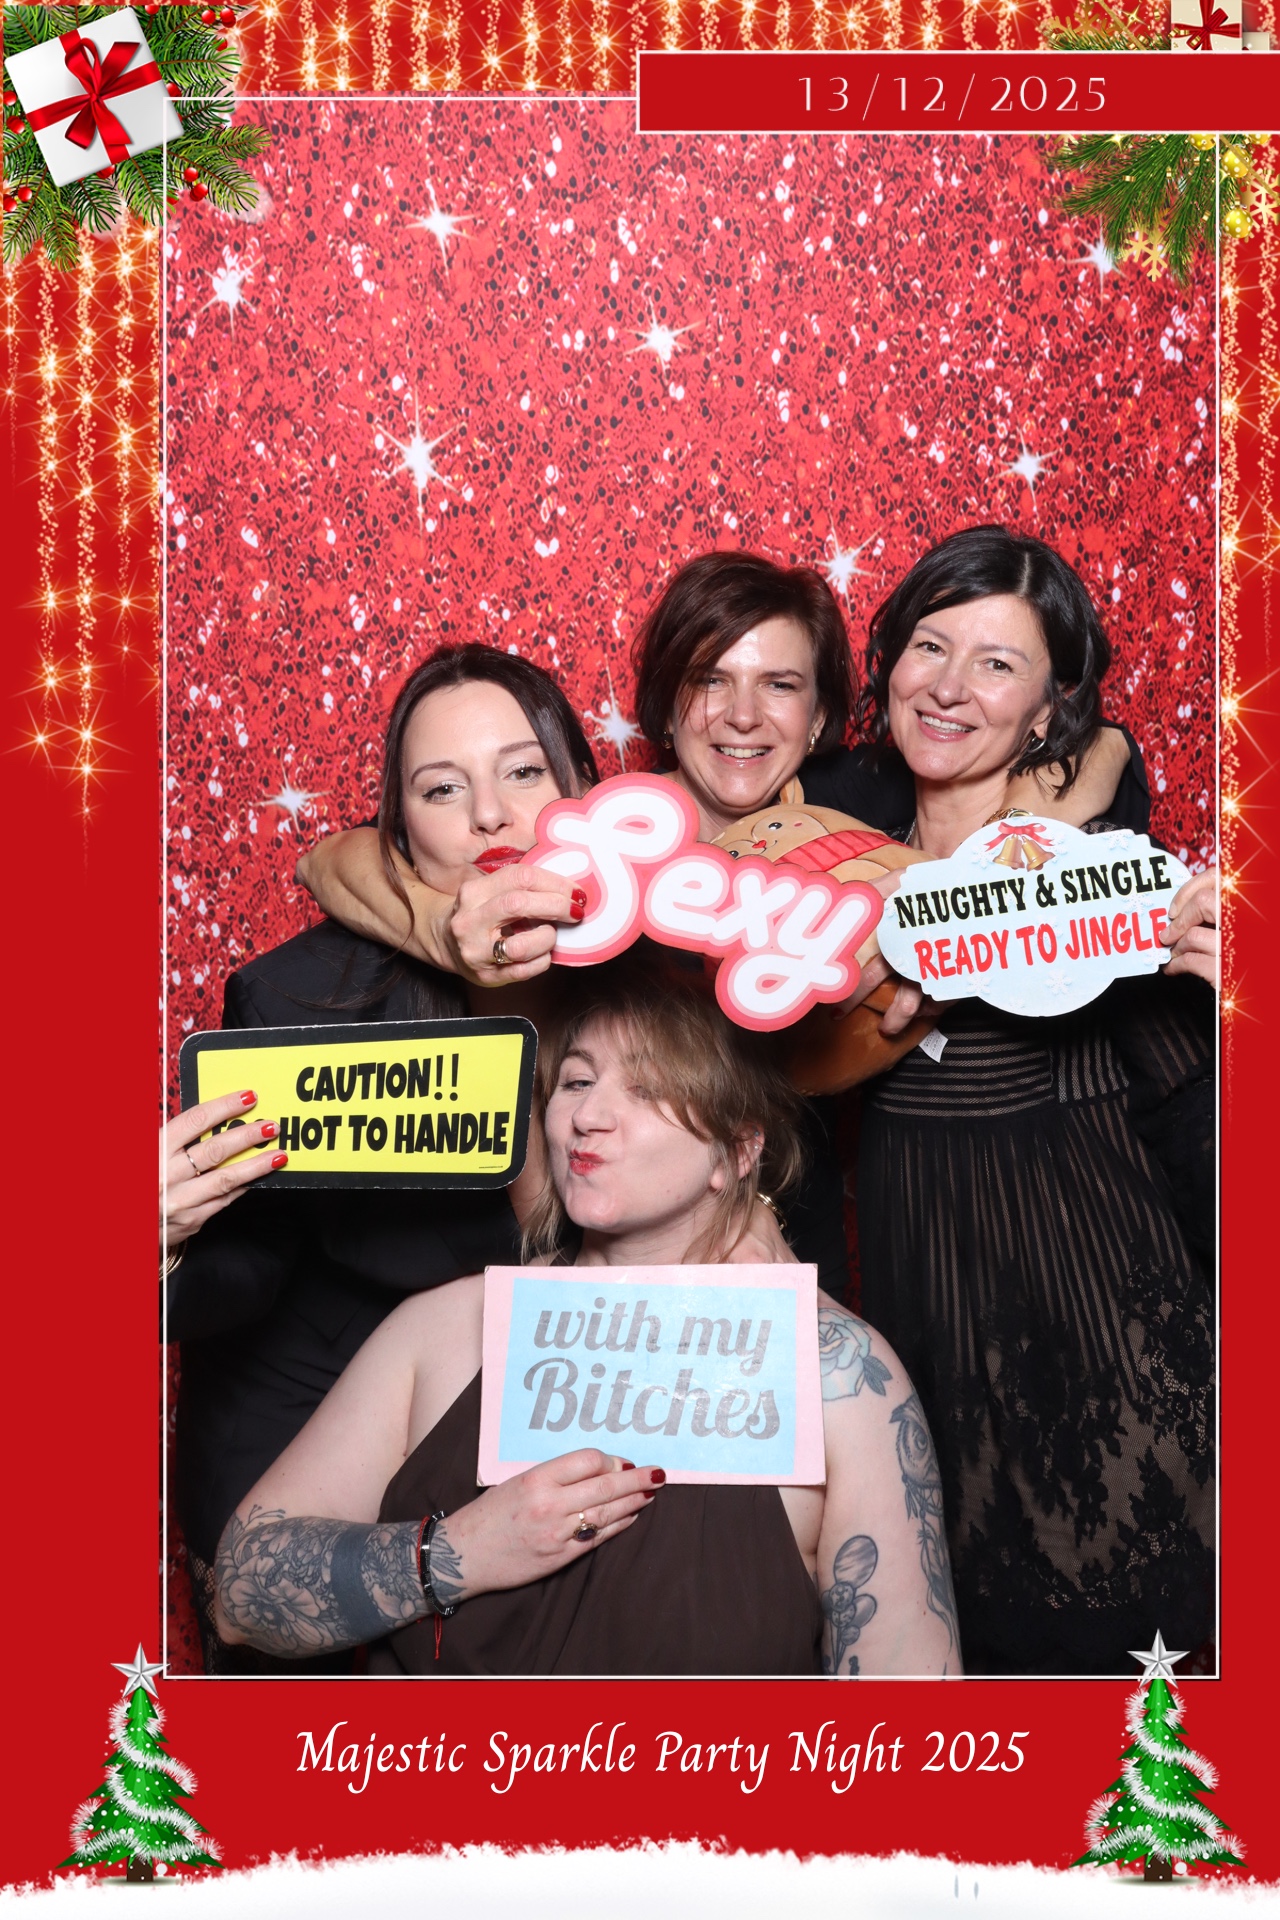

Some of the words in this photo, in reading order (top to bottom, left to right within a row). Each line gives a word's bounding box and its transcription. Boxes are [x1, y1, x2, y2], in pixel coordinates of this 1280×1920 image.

[540, 791, 866, 1014] Sexy
[894, 877, 1026, 929] NAUGHTY
[1035, 873, 1058, 908] &
[1060, 855, 1172, 904] SINGLE
[914, 929, 1009, 980] READY
[1016, 924, 1057, 966] TO
[1065, 908, 1168, 960] JINGLE
[296, 1053, 460, 1103] CAUTION!!
[278, 1115, 342, 1152] HOT
[349, 1115, 388, 1152] TO
[394, 1111, 510, 1155] HANDLE
[533, 1297, 661, 1354] with
[676, 1315, 773, 1377] my
[523, 1357, 781, 1440] Bitches
